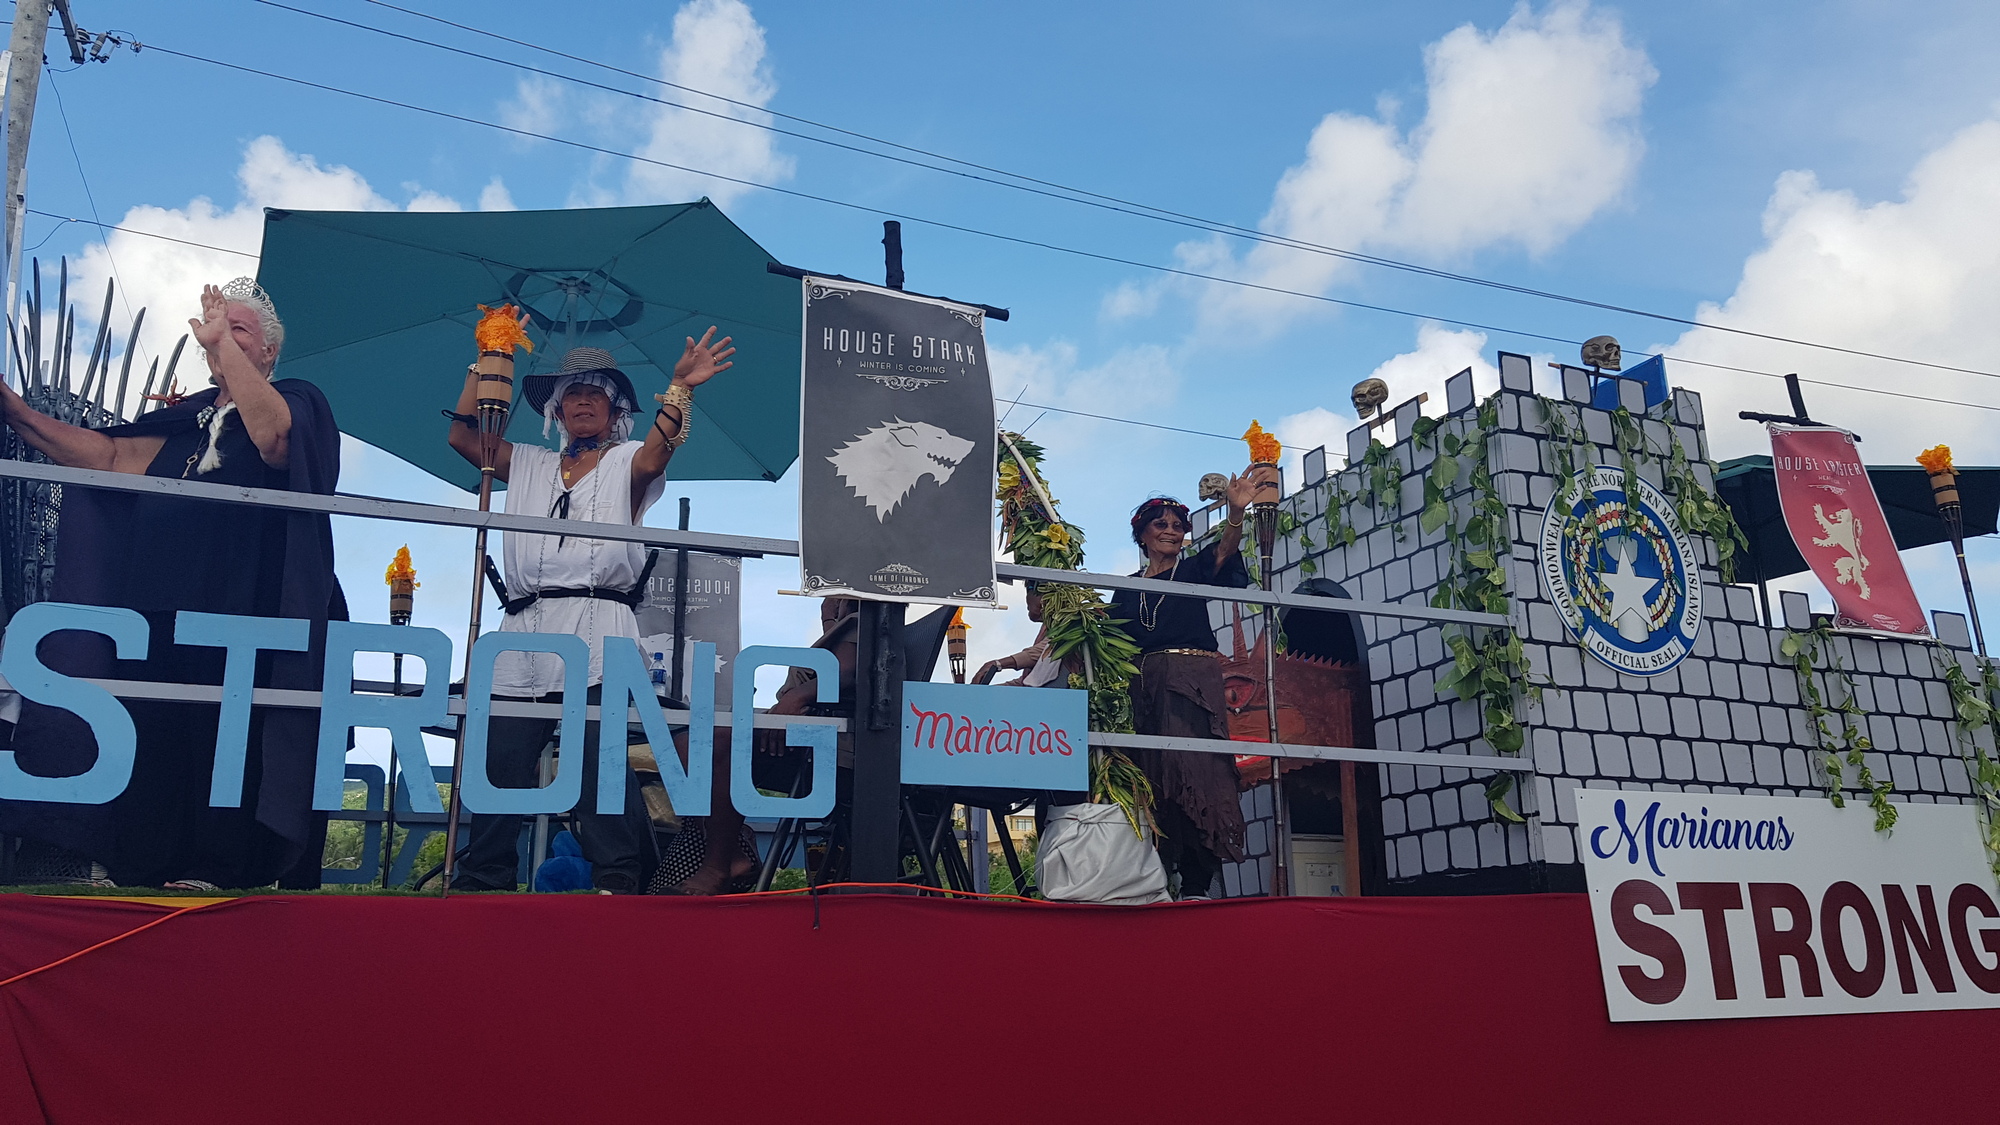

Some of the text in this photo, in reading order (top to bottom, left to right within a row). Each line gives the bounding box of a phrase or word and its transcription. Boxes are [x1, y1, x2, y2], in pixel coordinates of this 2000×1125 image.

[823, 327, 976, 366] HOUSE STARK
[859, 360, 946, 374] WINTER IS COMING
[1777, 456, 1820, 471] HOUSE
[869, 574, 929, 585] GAME OF THRONES
[1660, 506, 1693, 568] MARIANA
[1685, 572, 1699, 629] ISLANDS
[1596, 641, 1677, 669] OFFICIAL SEAL
[0, 602, 839, 819] STRONG
[909, 700, 1073, 756] Marianas
[1590, 798, 1795, 877] Marianas
[1610, 878, 2000, 1005] STRONG
